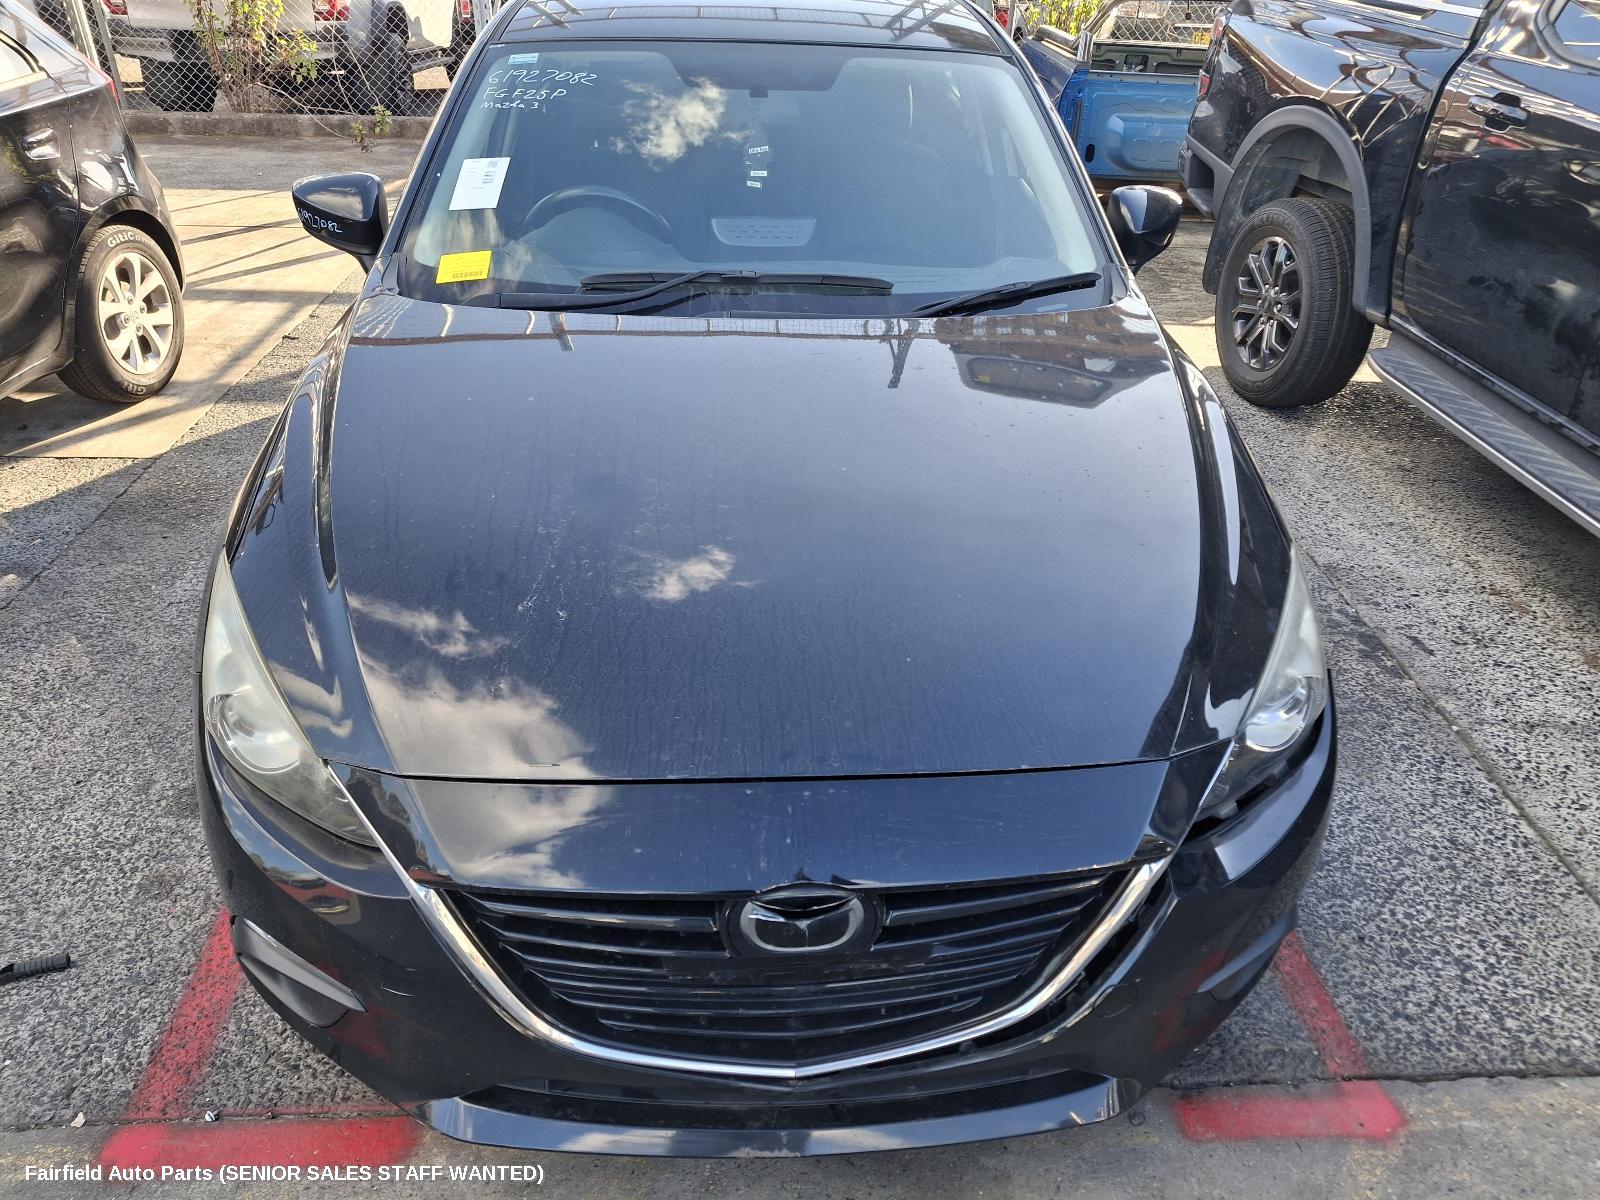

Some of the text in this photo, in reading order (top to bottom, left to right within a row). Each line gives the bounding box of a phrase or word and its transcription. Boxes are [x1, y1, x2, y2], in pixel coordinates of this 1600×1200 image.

[488, 69, 598, 86] 61927082
[480, 100, 539, 109] Mazda 3
